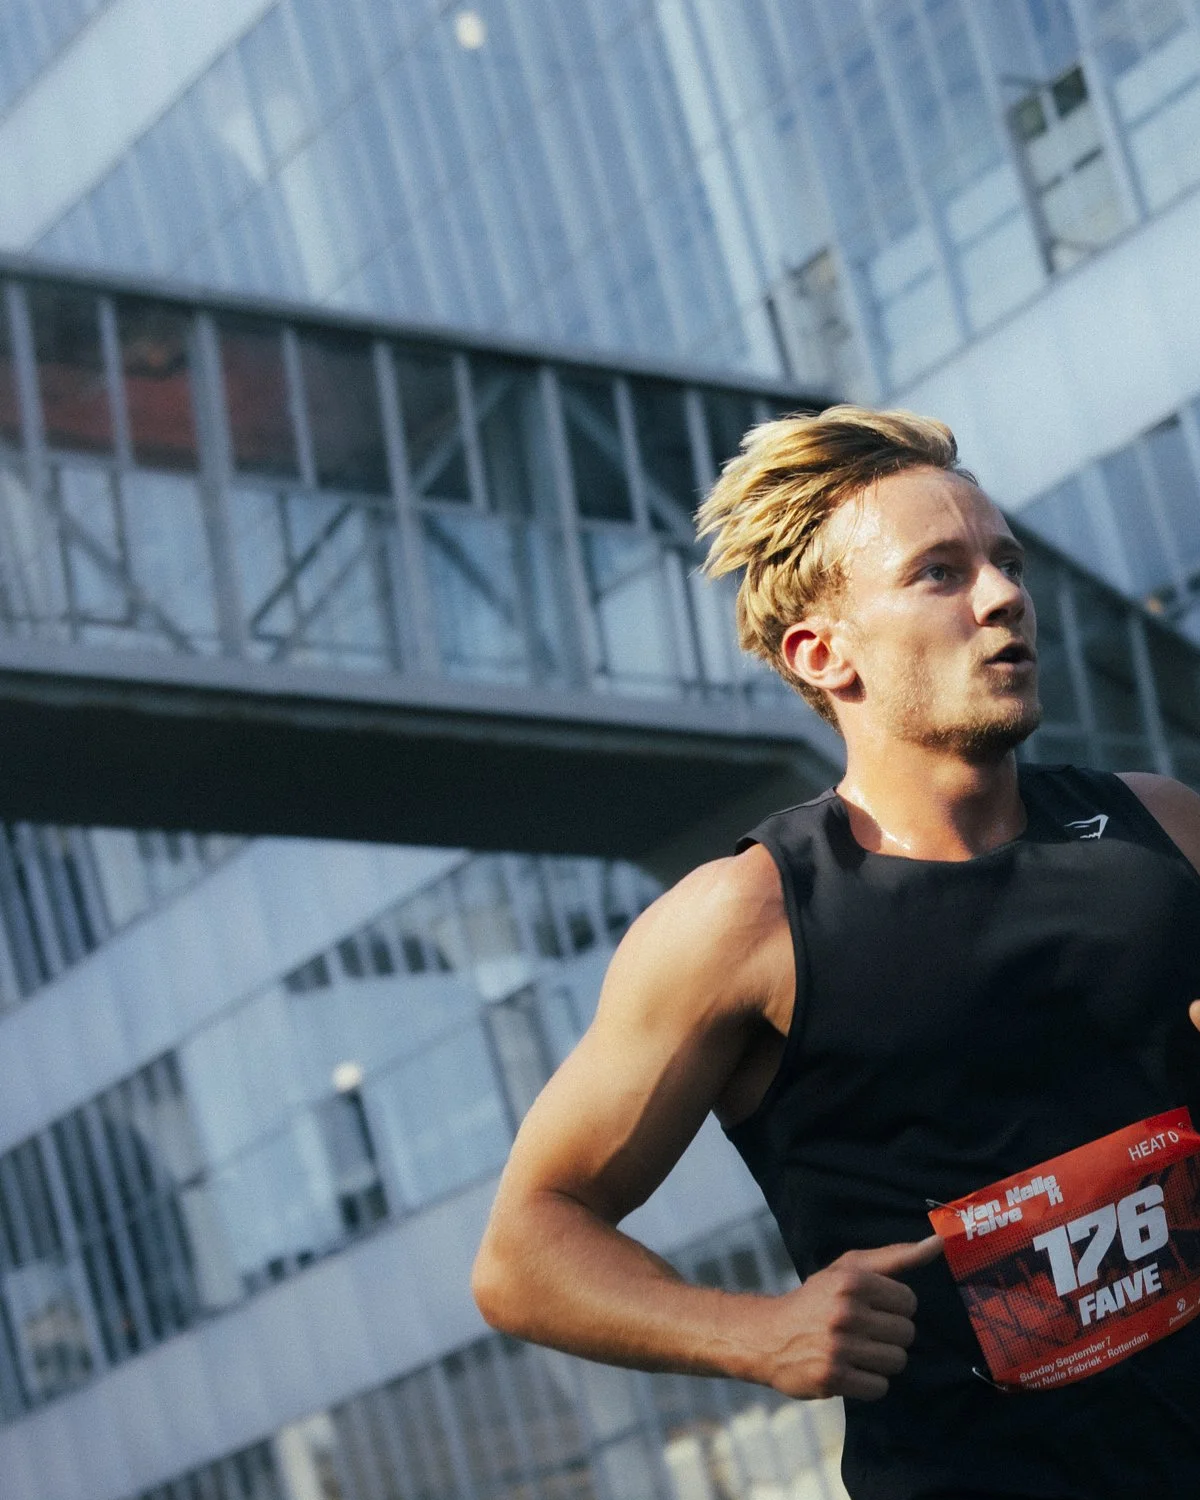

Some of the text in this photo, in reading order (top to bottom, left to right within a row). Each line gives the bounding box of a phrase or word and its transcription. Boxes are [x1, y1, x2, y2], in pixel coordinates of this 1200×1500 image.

[1128, 1133, 1166, 1161] HEAT
[960, 1175, 1057, 1226] Van Nelle
[965, 1207, 1023, 1240] Faive
[1033, 1184, 1169, 1297] 176
[1078, 1262, 1162, 1327] FAIVE
[1020, 1336, 1111, 1382] Sunday September 7
[1042, 1371, 1067, 1386] Nelle
[1067, 1355, 1102, 1376] Fabriek
[1107, 1332, 1149, 1358] Rotterdam
